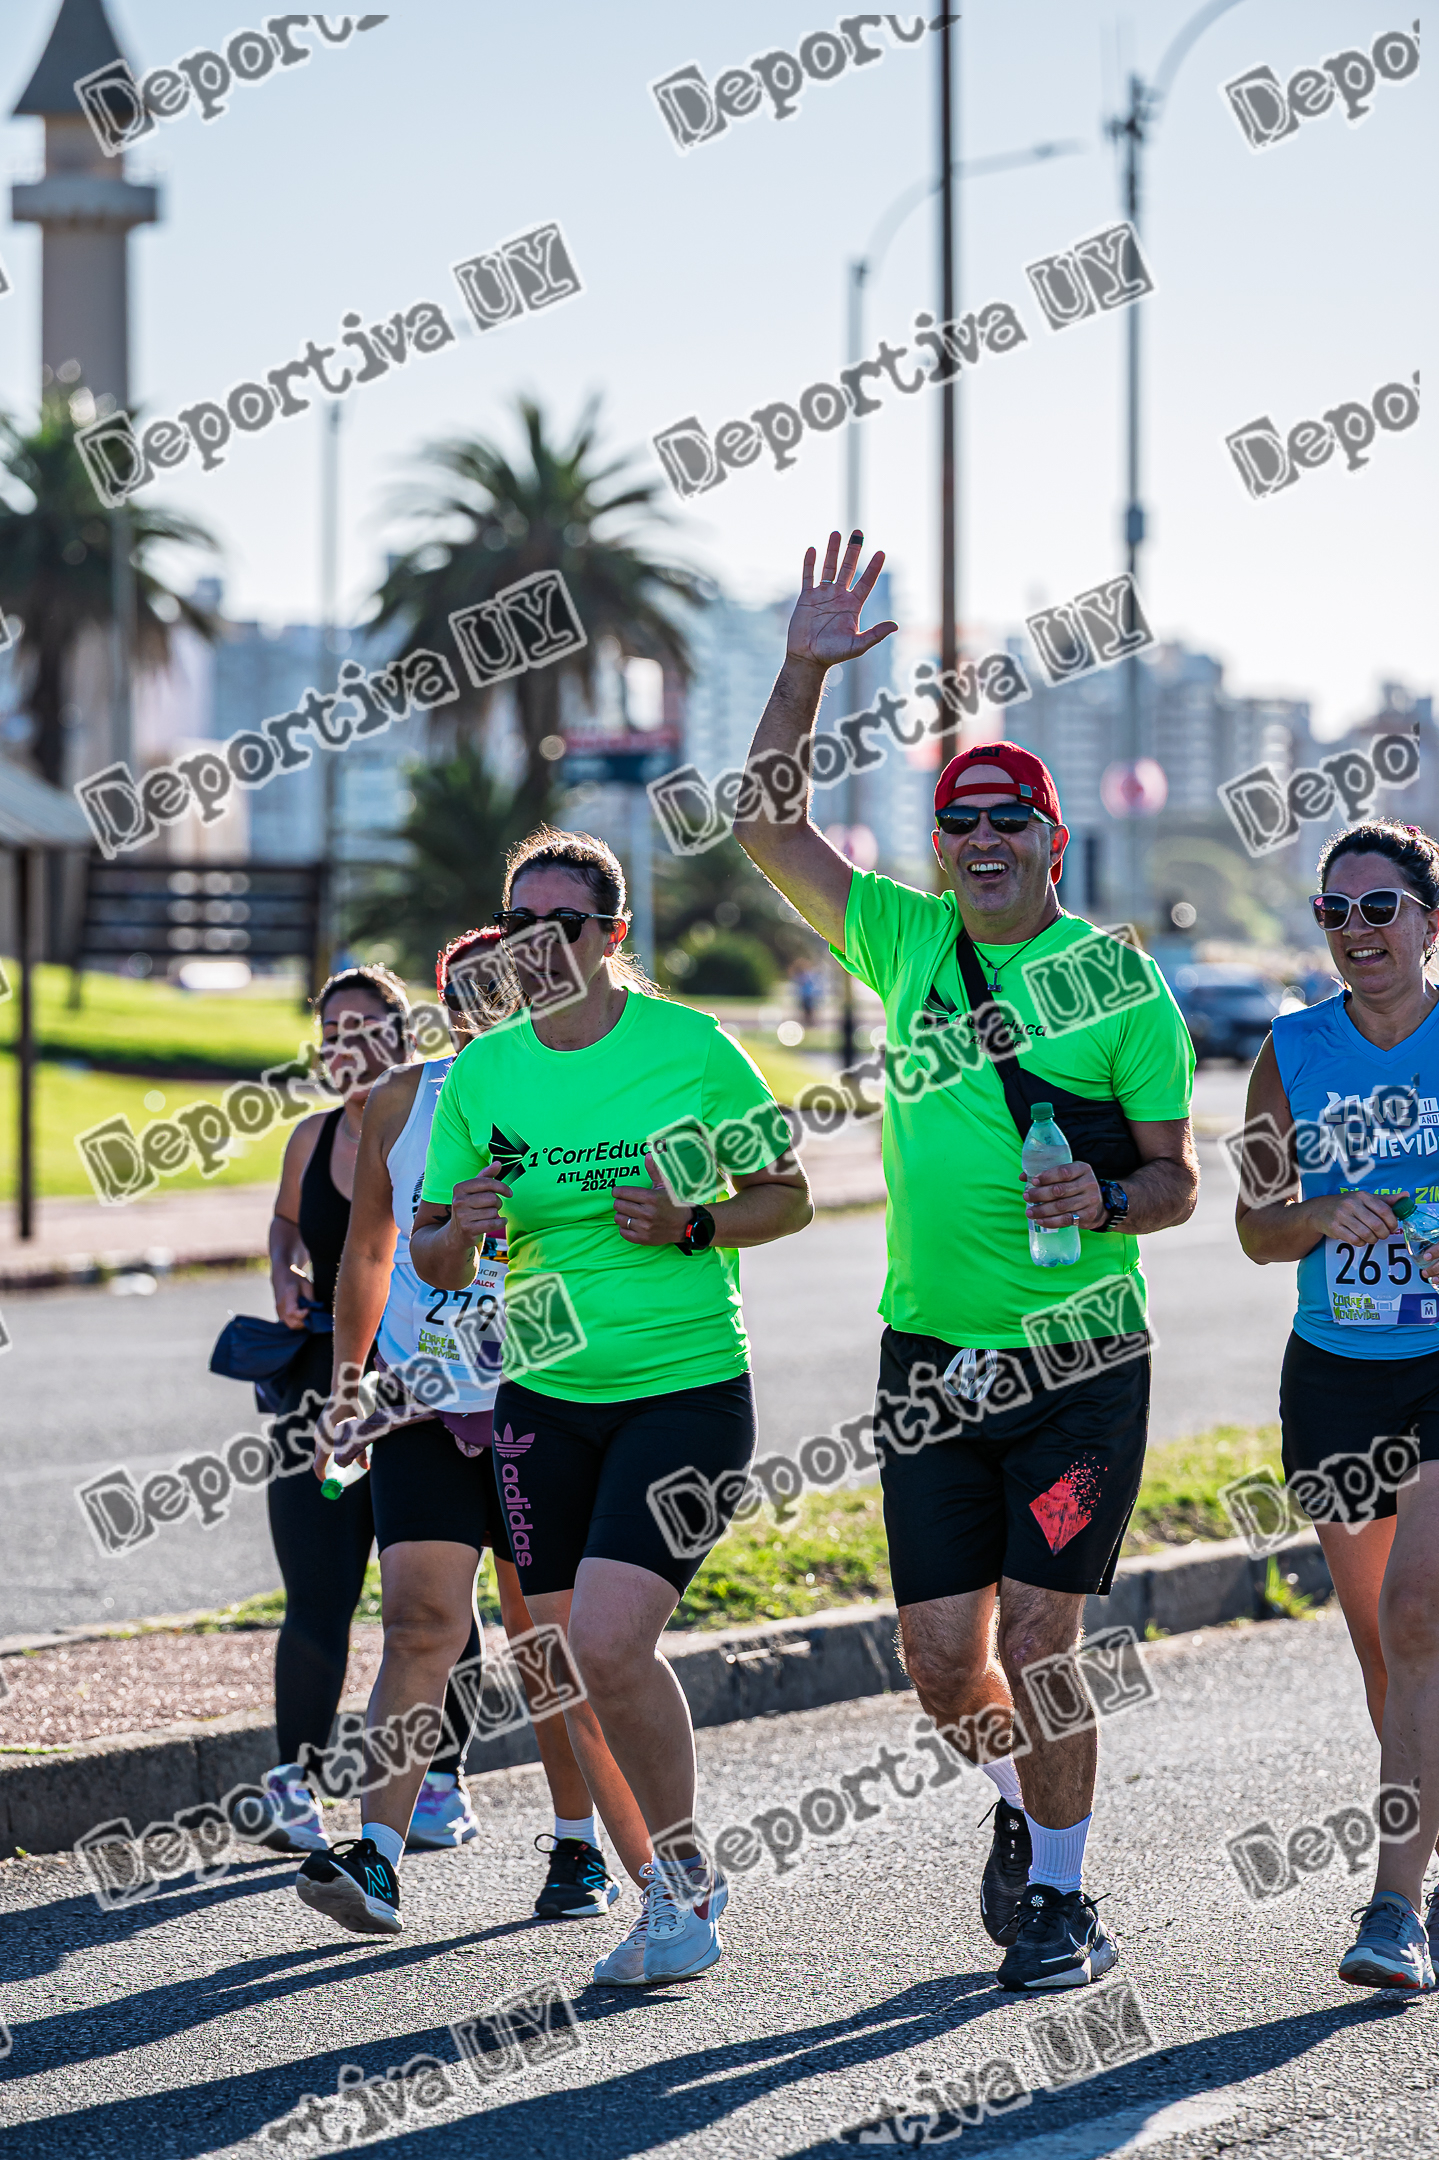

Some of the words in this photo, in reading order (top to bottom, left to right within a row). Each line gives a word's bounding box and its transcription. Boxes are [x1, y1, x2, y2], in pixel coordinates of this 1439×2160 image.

[1320, 1123, 1439, 1165] MONTEVID
[556, 1165, 641, 1184] ATLANTIDA
[580, 1178, 617, 1192] 2024
[1335, 1242, 1430, 1286] 265
[502, 1463, 534, 1568] adidas
